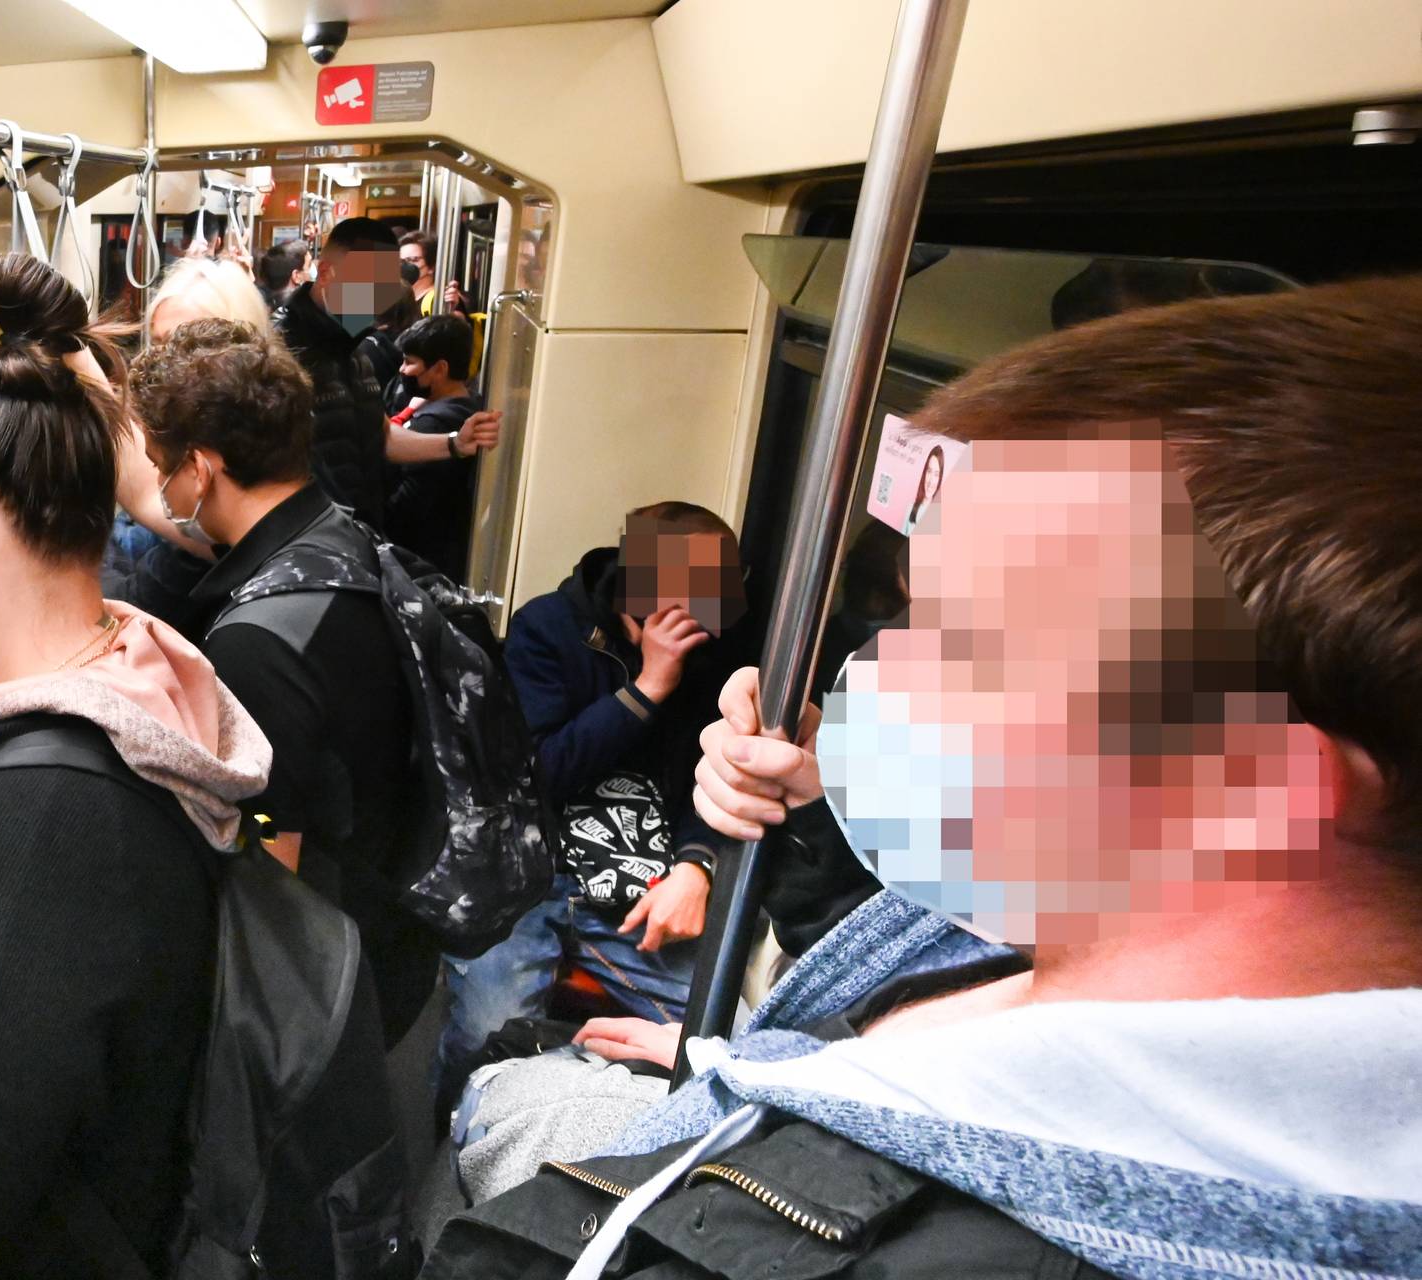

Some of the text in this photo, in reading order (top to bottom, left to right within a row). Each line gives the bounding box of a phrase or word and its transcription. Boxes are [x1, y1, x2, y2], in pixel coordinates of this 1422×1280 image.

[606, 777, 645, 794] NIKE
[578, 816, 615, 841] NIKE
[619, 805, 640, 842] NIKE
[618, 861, 656, 883] NIKE
